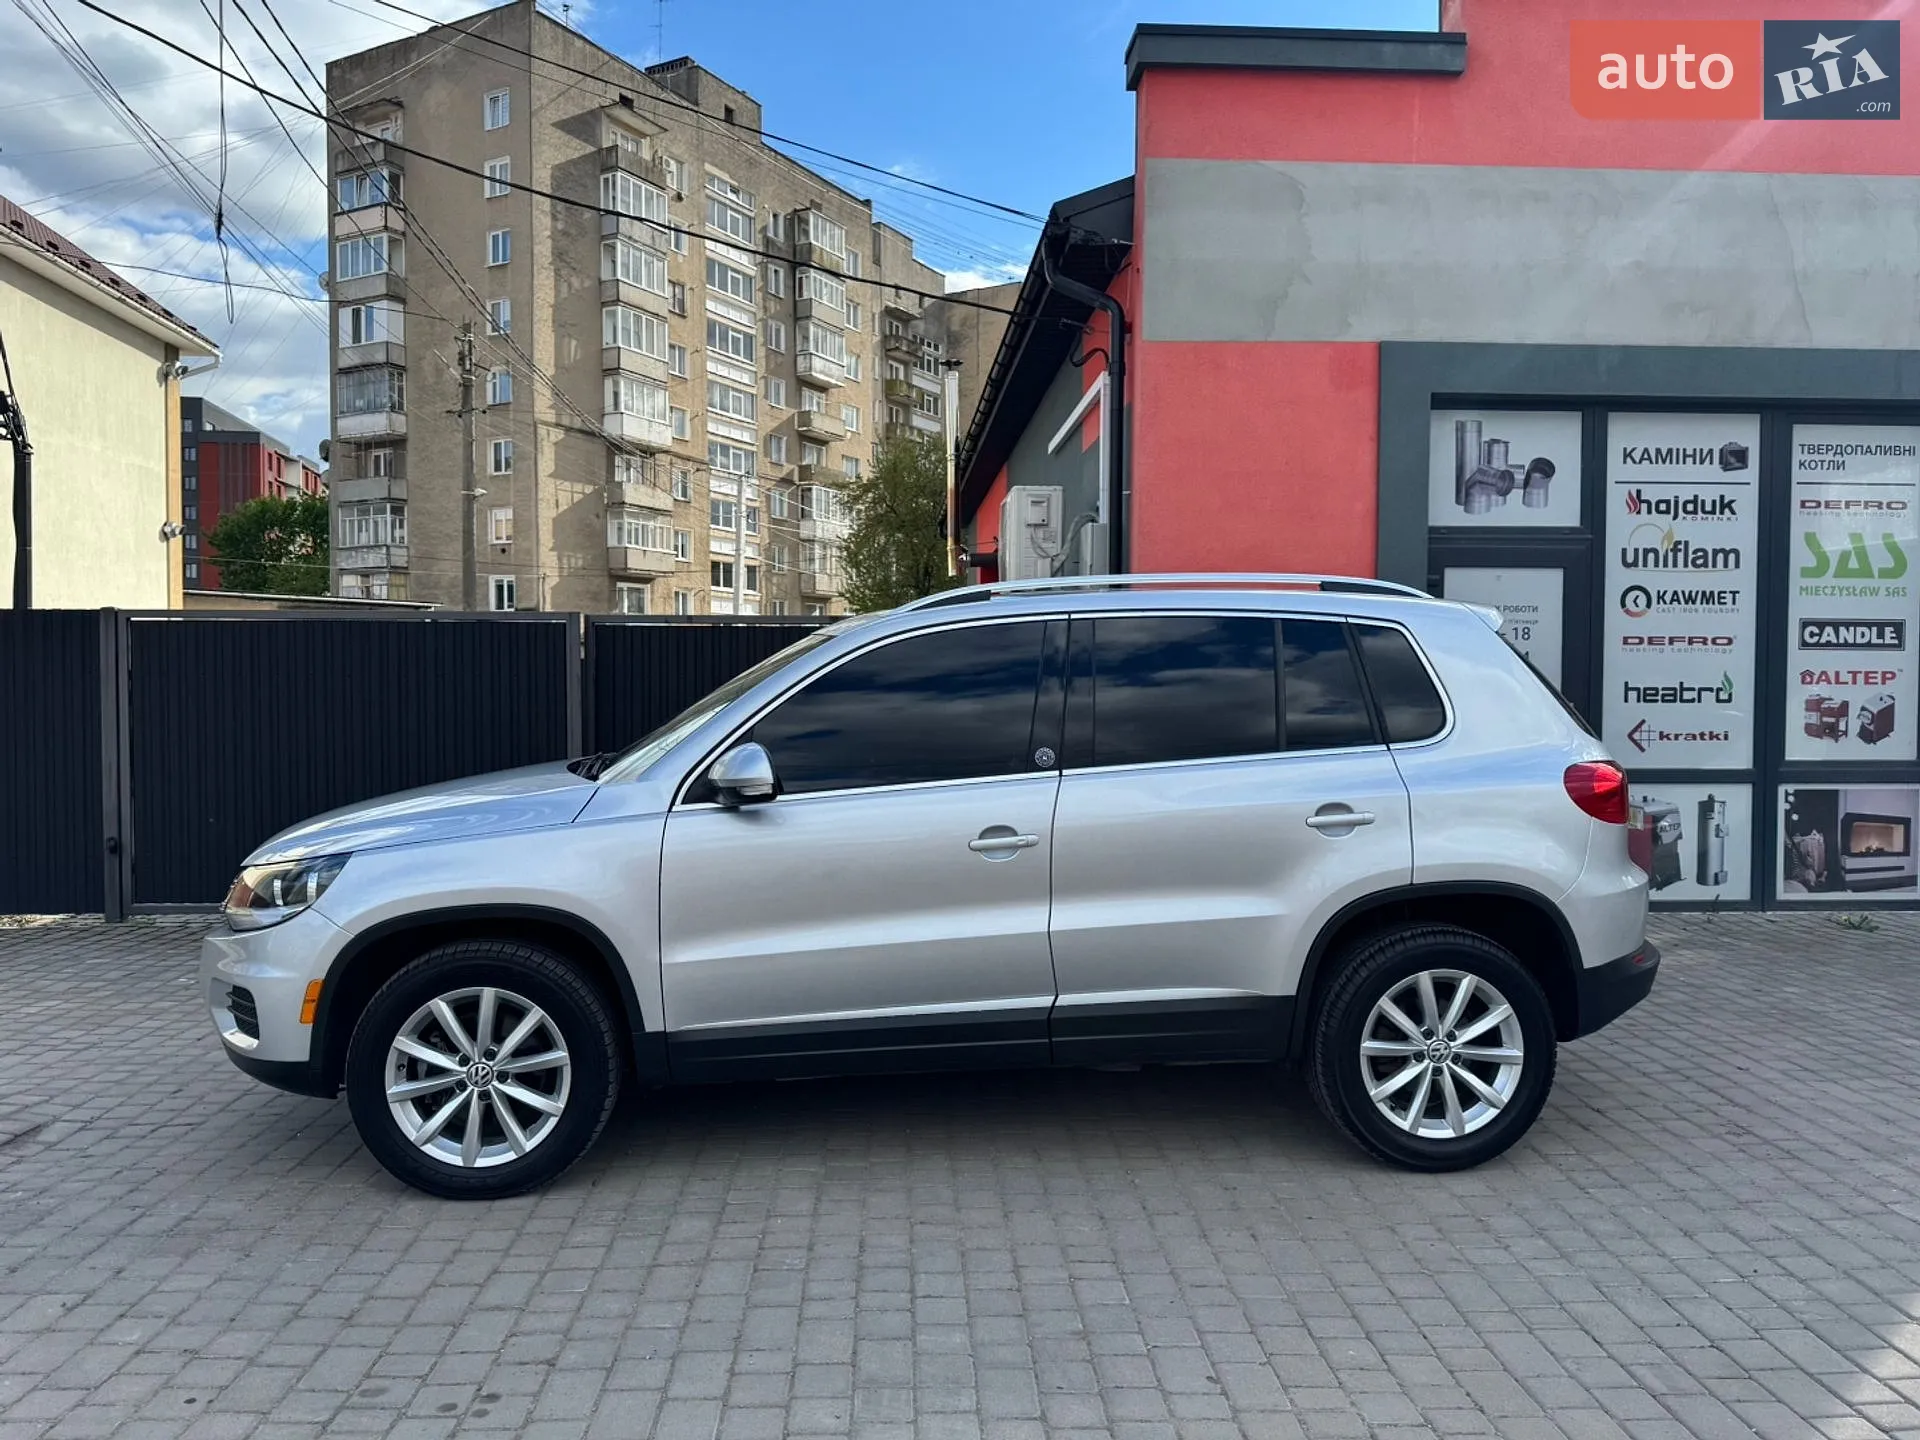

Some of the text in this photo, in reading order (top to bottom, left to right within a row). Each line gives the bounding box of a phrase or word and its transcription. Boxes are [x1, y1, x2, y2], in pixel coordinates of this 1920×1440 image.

[1622, 447, 1715, 465] КАМІНИ
[1798, 443, 1917, 458] ТВЕРДОПАЛИВНІ
[1798, 460, 1846, 471] КОТЛИ
[1635, 488, 1738, 521] hajduk
[1800, 500, 1908, 511] DEFRO
[1621, 540, 1741, 569] uniflam
[1800, 531, 1908, 579] SAS
[1656, 589, 1741, 606] KAWMET
[1884, 586, 1908, 598] SAS
[1503, 605, 1539, 614] РОБОТИ
[1511, 626, 1531, 641] 18
[1803, 625, 1899, 644] CANDLE
[1622, 636, 1734, 647] DEFRO
[1815, 670, 1897, 685] ALTEP
[1624, 681, 1733, 704] heatro
[1658, 730, 1729, 742] kratki
